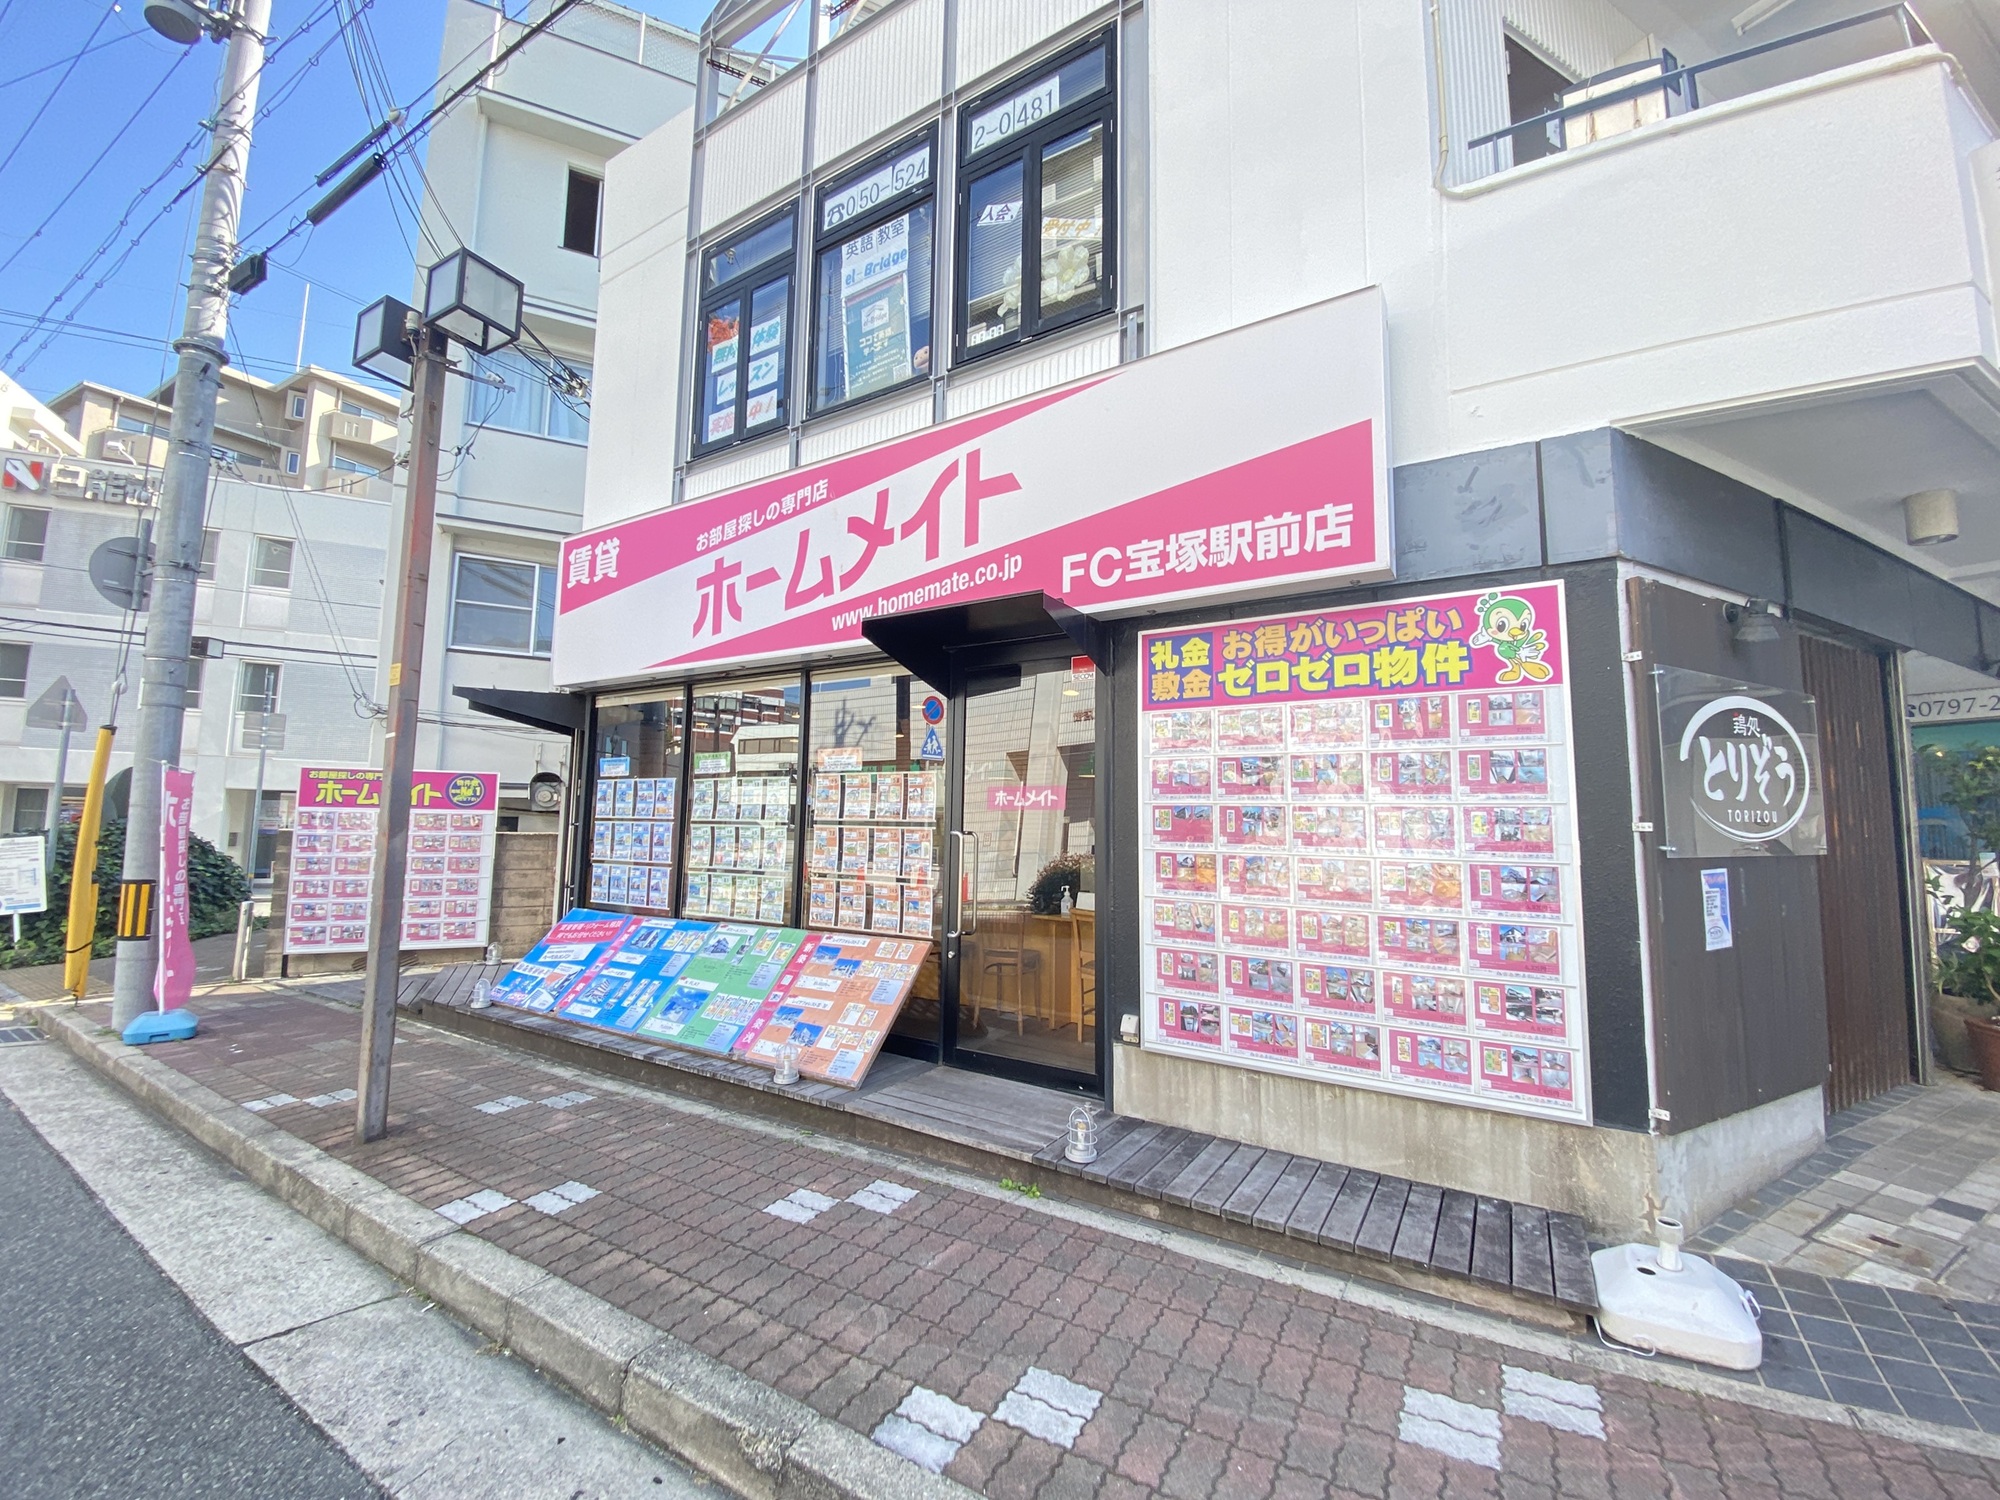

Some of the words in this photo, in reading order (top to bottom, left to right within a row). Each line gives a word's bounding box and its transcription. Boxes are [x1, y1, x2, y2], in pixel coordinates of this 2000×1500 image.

[845, 218, 905, 260] 英語教室
[695, 478, 829, 552] お部屋探しの専門店
[566, 536, 620, 589] 賃貸
[692, 448, 1023, 639] ホームメイト
[1062, 503, 1353, 593] FC宝塚駅前店
[831, 552, 1022, 631] www.homemate.co.jp
[1151, 637, 1211, 670] 礼金
[1222, 606, 1462, 660] お得がいっぱい
[1151, 669, 1212, 702] 敷金
[1217, 641, 1470, 698] ゼロゼロ物件
[314, 780, 443, 806] ホームイト
[1698, 733, 1796, 807] とりぞう
[994, 789, 1058, 806] ホームメイト
[1727, 809, 1778, 824] TORIZOU
